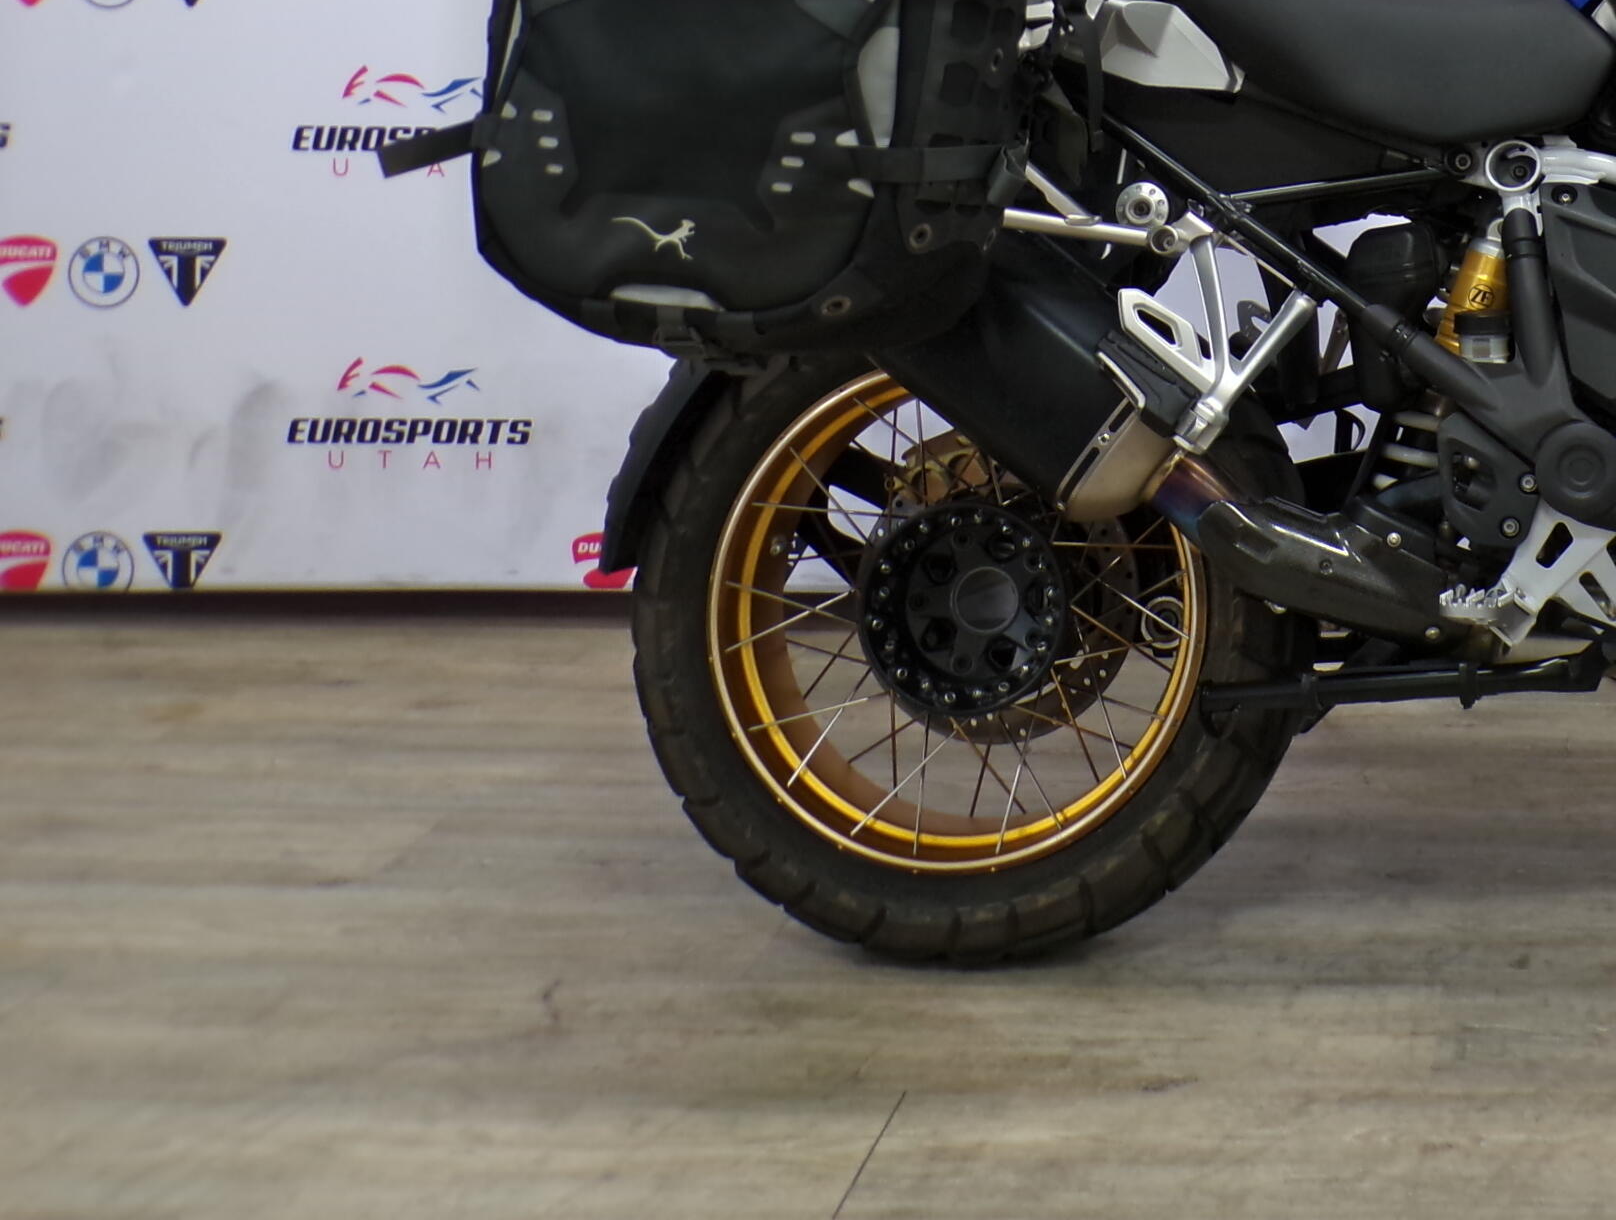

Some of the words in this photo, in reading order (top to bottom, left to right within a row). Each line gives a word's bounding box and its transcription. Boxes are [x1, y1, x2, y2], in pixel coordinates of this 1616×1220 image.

[78, 239, 130, 260] BMW
[287, 418, 532, 445] EUROSPORTS
[329, 451, 493, 470] UTAH
[0, 541, 46, 555] UCATI
[72, 535, 125, 555] BMW
